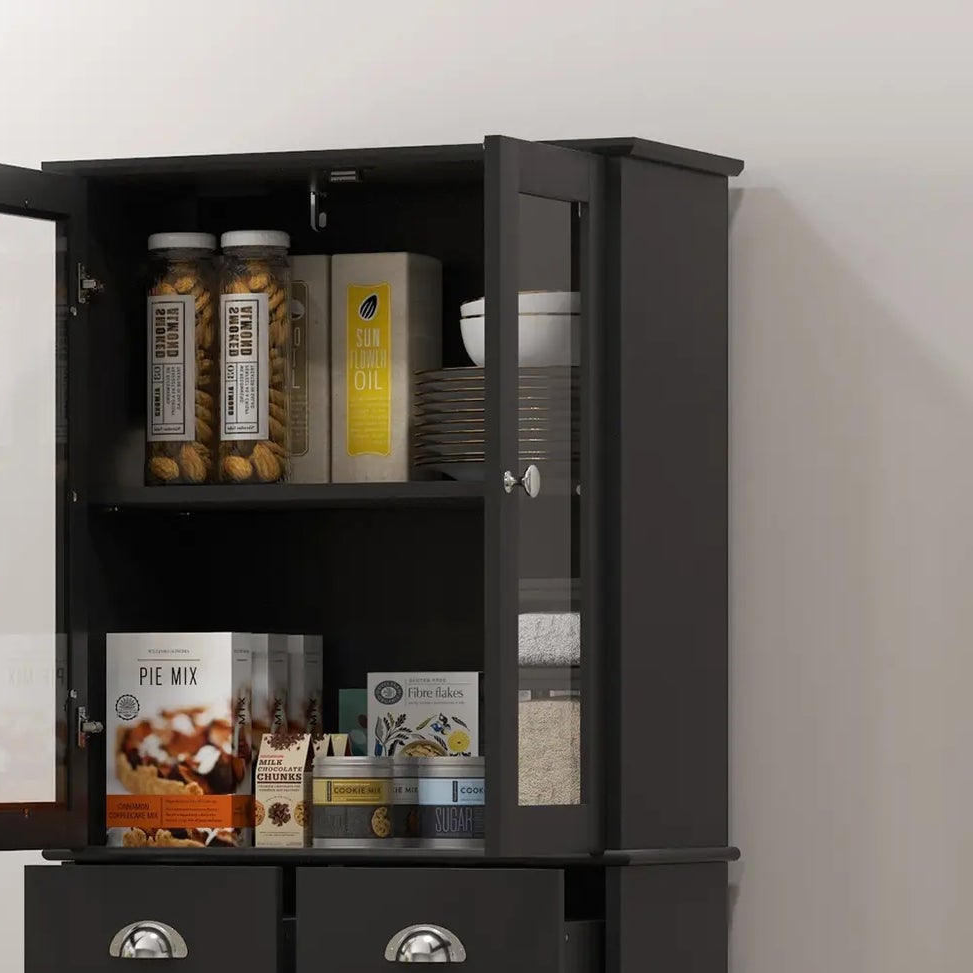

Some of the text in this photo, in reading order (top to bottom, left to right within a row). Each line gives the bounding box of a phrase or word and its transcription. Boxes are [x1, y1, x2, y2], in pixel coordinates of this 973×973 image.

[356, 328, 380, 347] SUN
[354, 370, 383, 390] OIL
[139, 666, 197, 686] PIE MIX
[408, 686, 464, 698] Fibre flakes
[238, 697, 246, 725] MIX
[274, 697, 282, 725] MIX
[257, 773, 302, 781] CHUNKS
[435, 806, 473, 833] SUGAR
